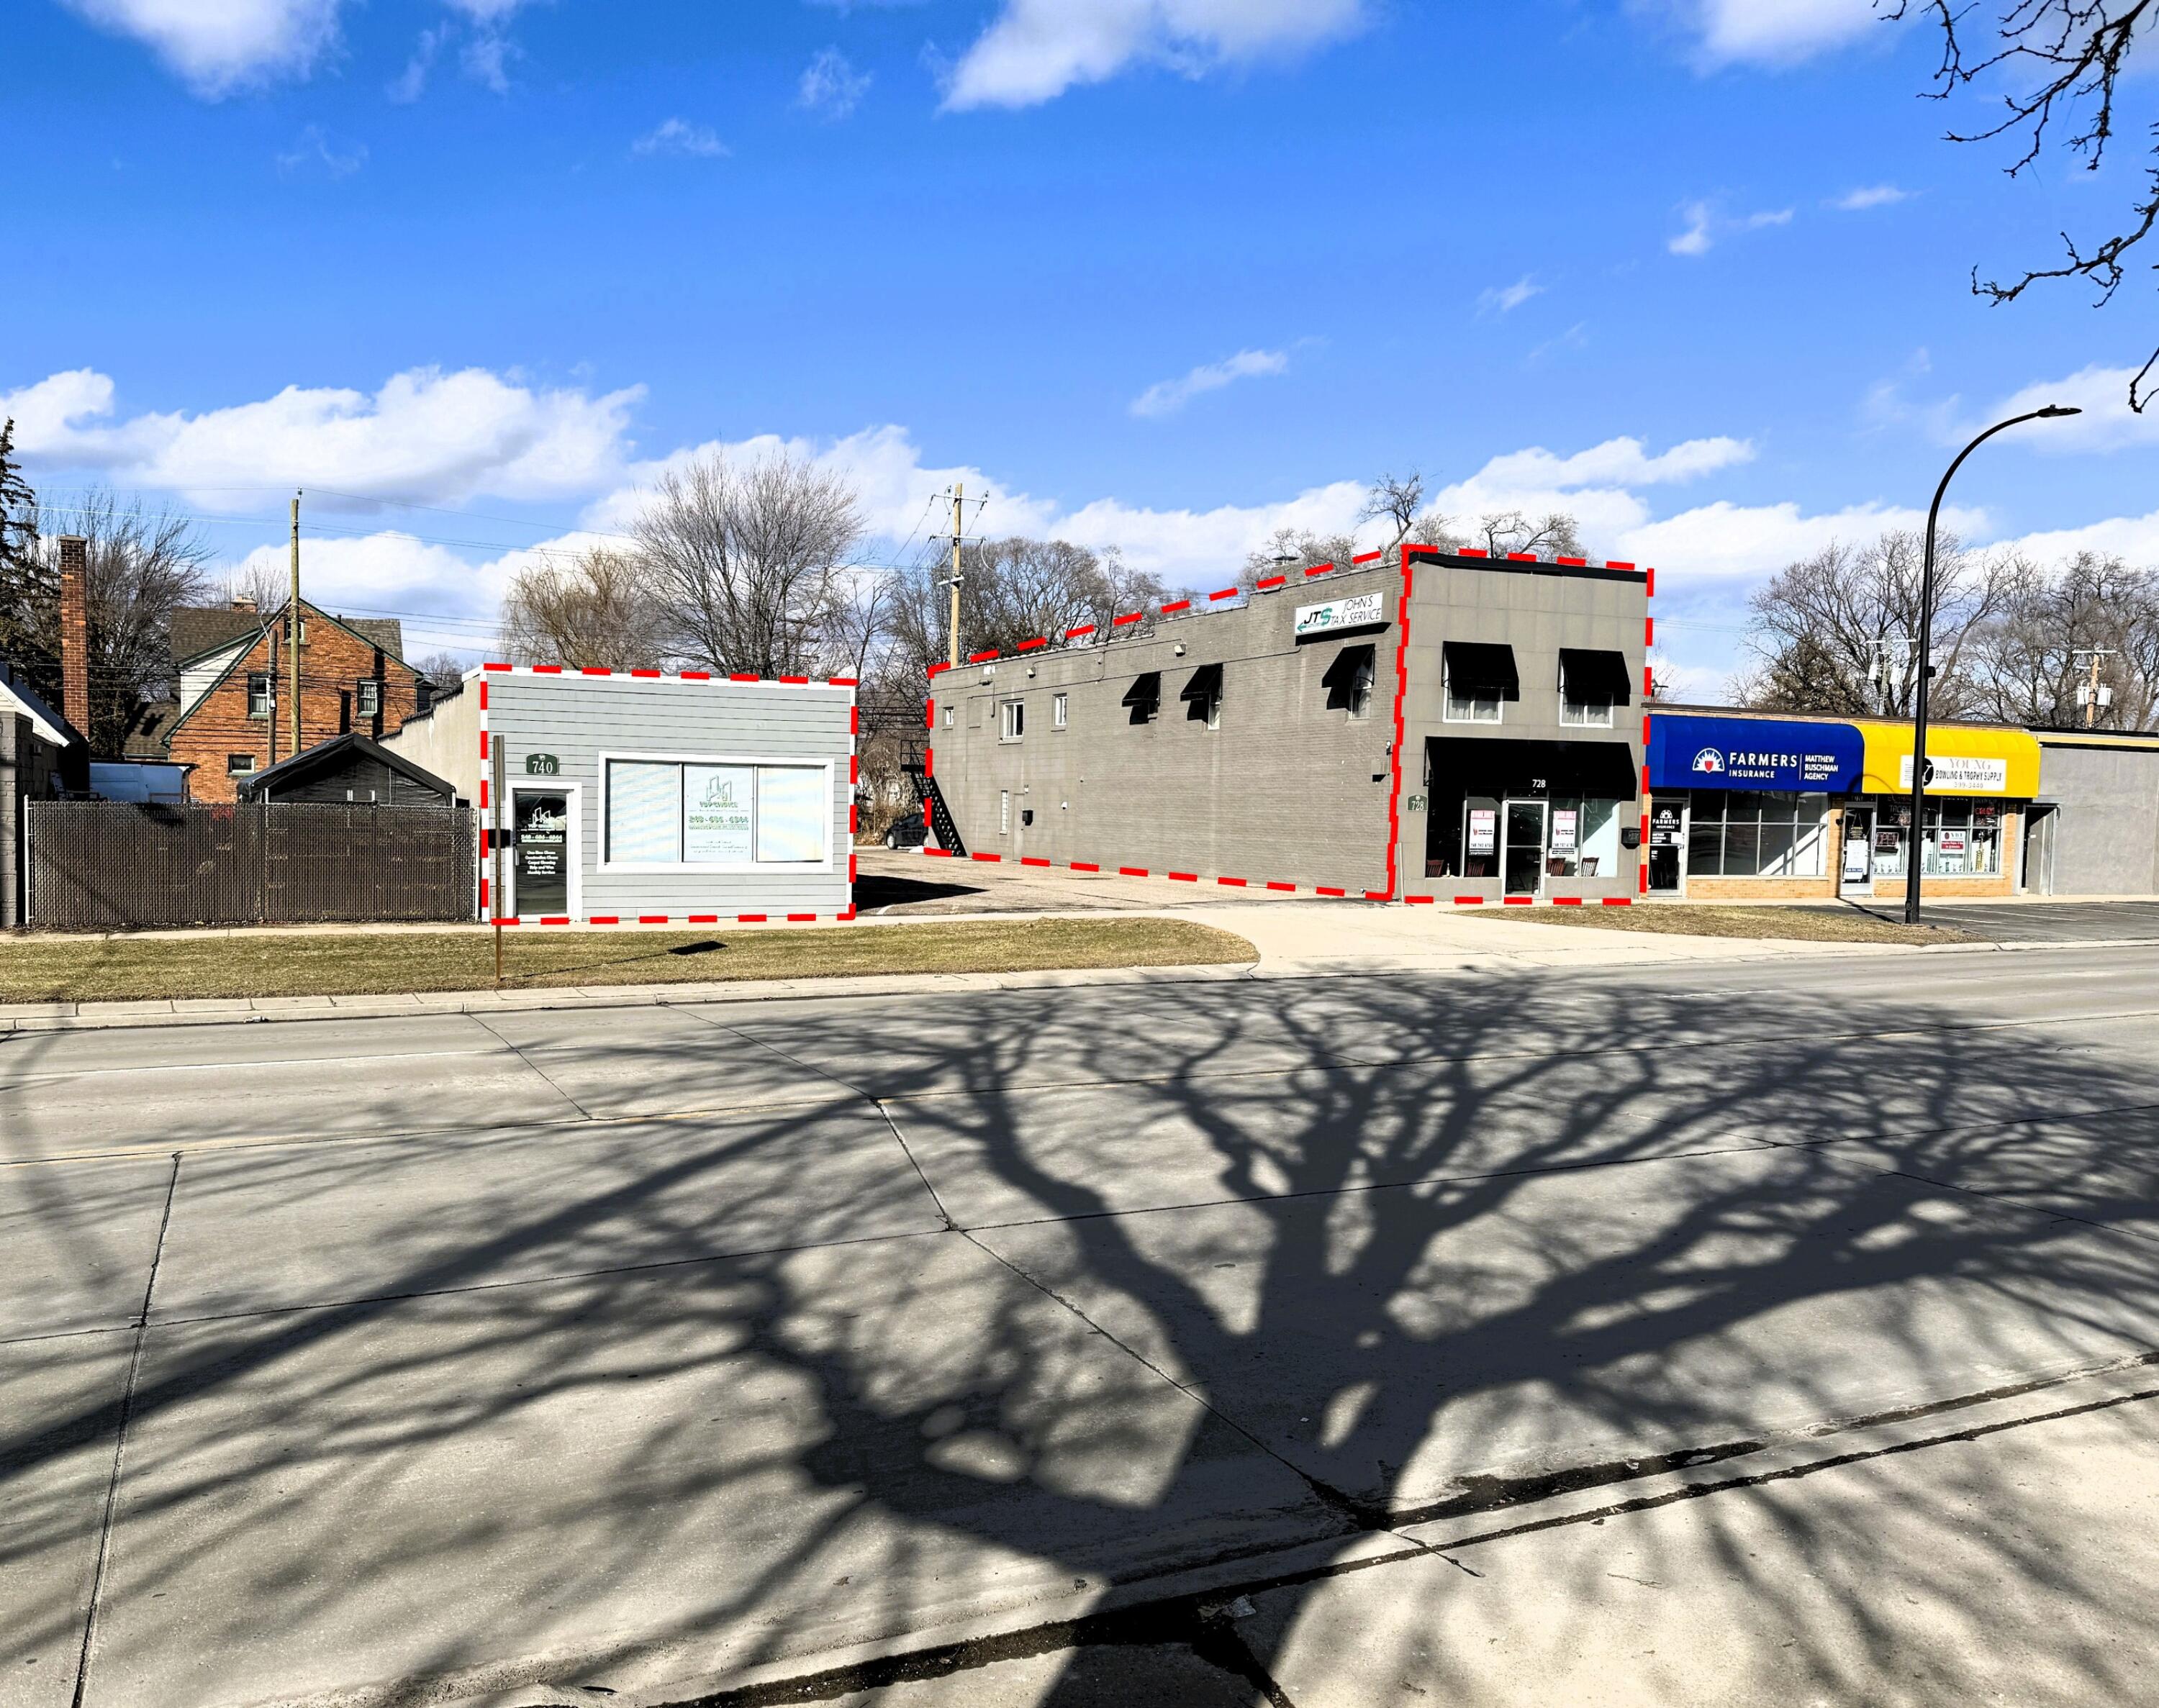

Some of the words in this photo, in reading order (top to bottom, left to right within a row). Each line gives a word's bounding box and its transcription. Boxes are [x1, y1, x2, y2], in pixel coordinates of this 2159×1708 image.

[1331, 614, 1346, 626] TAX
[1349, 608, 1381, 624] SERVICE
[1729, 753, 1797, 767] FARMERS
[1950, 758, 1991, 770] YOUNG
[533, 761, 553, 773] 740
[1805, 763, 1838, 772] BUSCHMAN
[1729, 769, 1775, 778] INSURANCE
[1936, 770, 1957, 780] BOWLING
[1959, 771, 1963, 780] &
[1964, 771, 1983, 781] TROPHY
[1984, 772, 2002, 781] SUPPLY
[1532, 779, 1546, 788] 728
[1411, 801, 1424, 811] 728
